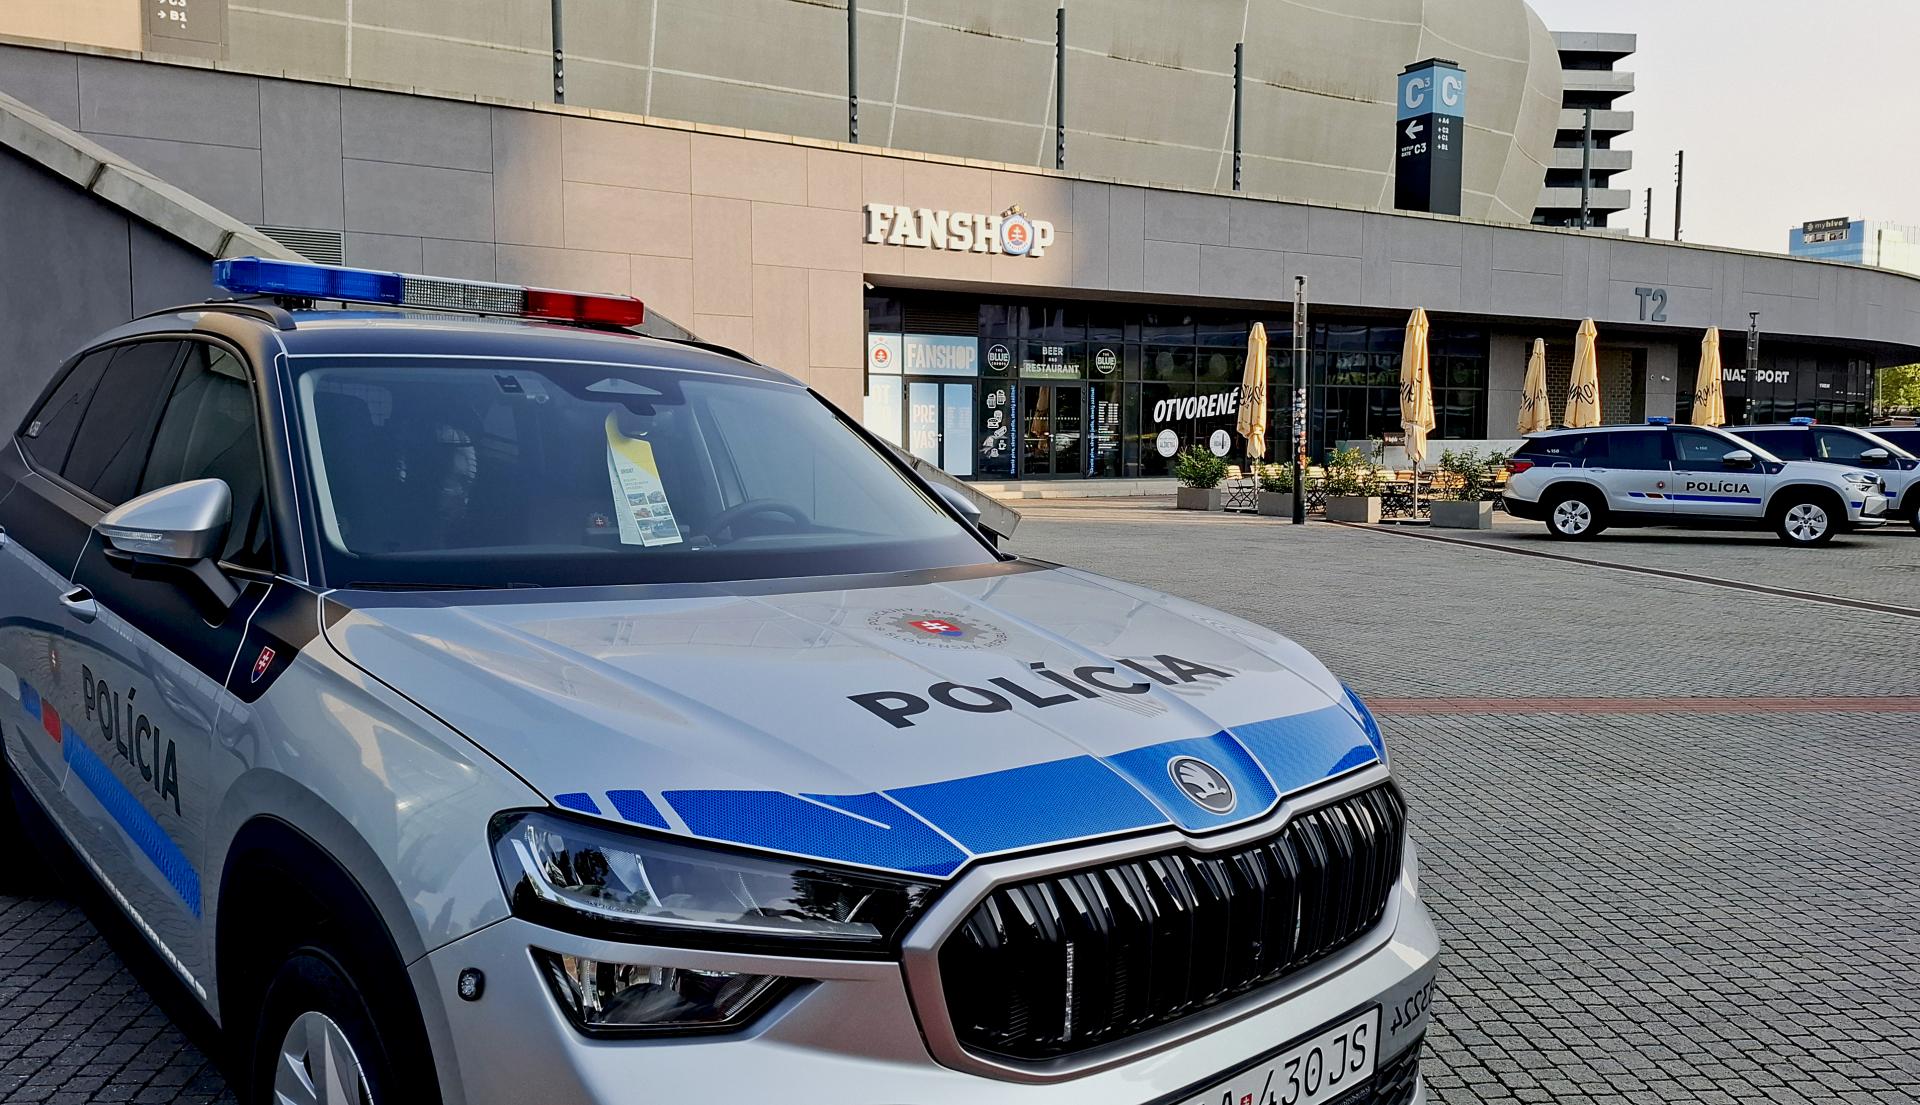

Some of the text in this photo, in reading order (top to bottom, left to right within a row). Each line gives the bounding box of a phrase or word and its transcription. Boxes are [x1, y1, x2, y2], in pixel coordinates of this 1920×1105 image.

[169, 10, 187, 22] B1
[1414, 142, 1427, 154] C3
[864, 203, 1055, 257] FANSHOP
[1635, 287, 1667, 322] T2
[907, 343, 976, 371] FANSHOP
[989, 352, 1009, 362] BLUE
[1042, 346, 1064, 356] BEER
[1025, 363, 1080, 374] RESTAURANT
[1097, 356, 1116, 366] BLUE
[912, 404, 936, 423] PRE
[1153, 387, 1239, 423] OTVORENÉ
[912, 425, 937, 449] VÁS
[1686, 480, 1750, 494] POLÍCIA
[846, 654, 1235, 730] POLÍCIA
[82, 663, 182, 817] POLÍCIA
